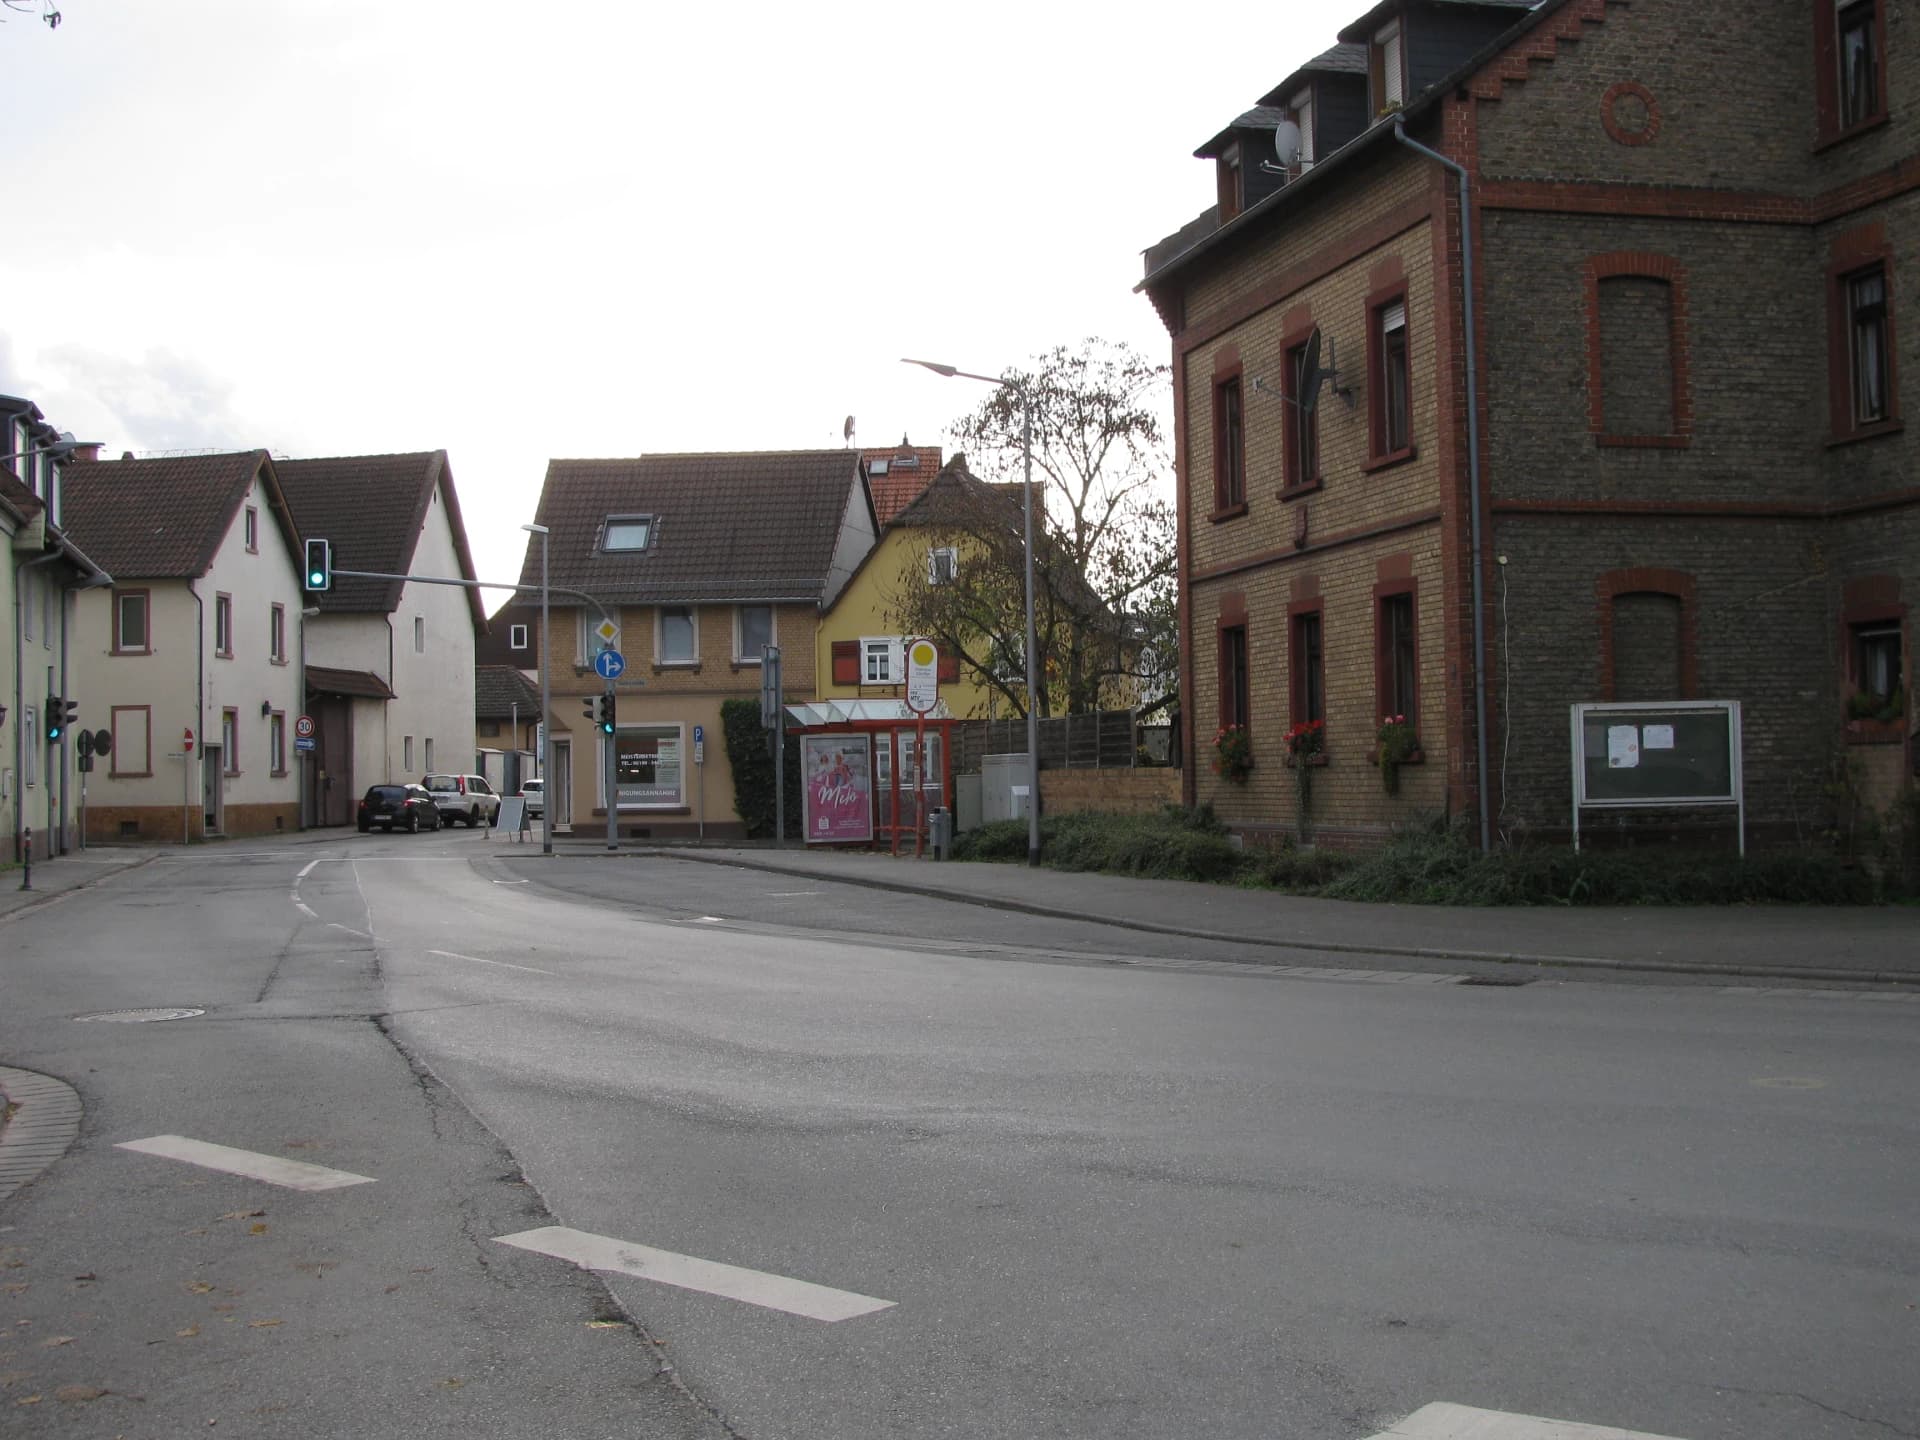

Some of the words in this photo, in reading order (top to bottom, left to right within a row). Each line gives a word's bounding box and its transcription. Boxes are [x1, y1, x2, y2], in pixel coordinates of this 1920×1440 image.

[299, 721, 310, 732] 30
[695, 728, 702, 741] P
[618, 789, 676, 797] NIGUNGSANNAHME
